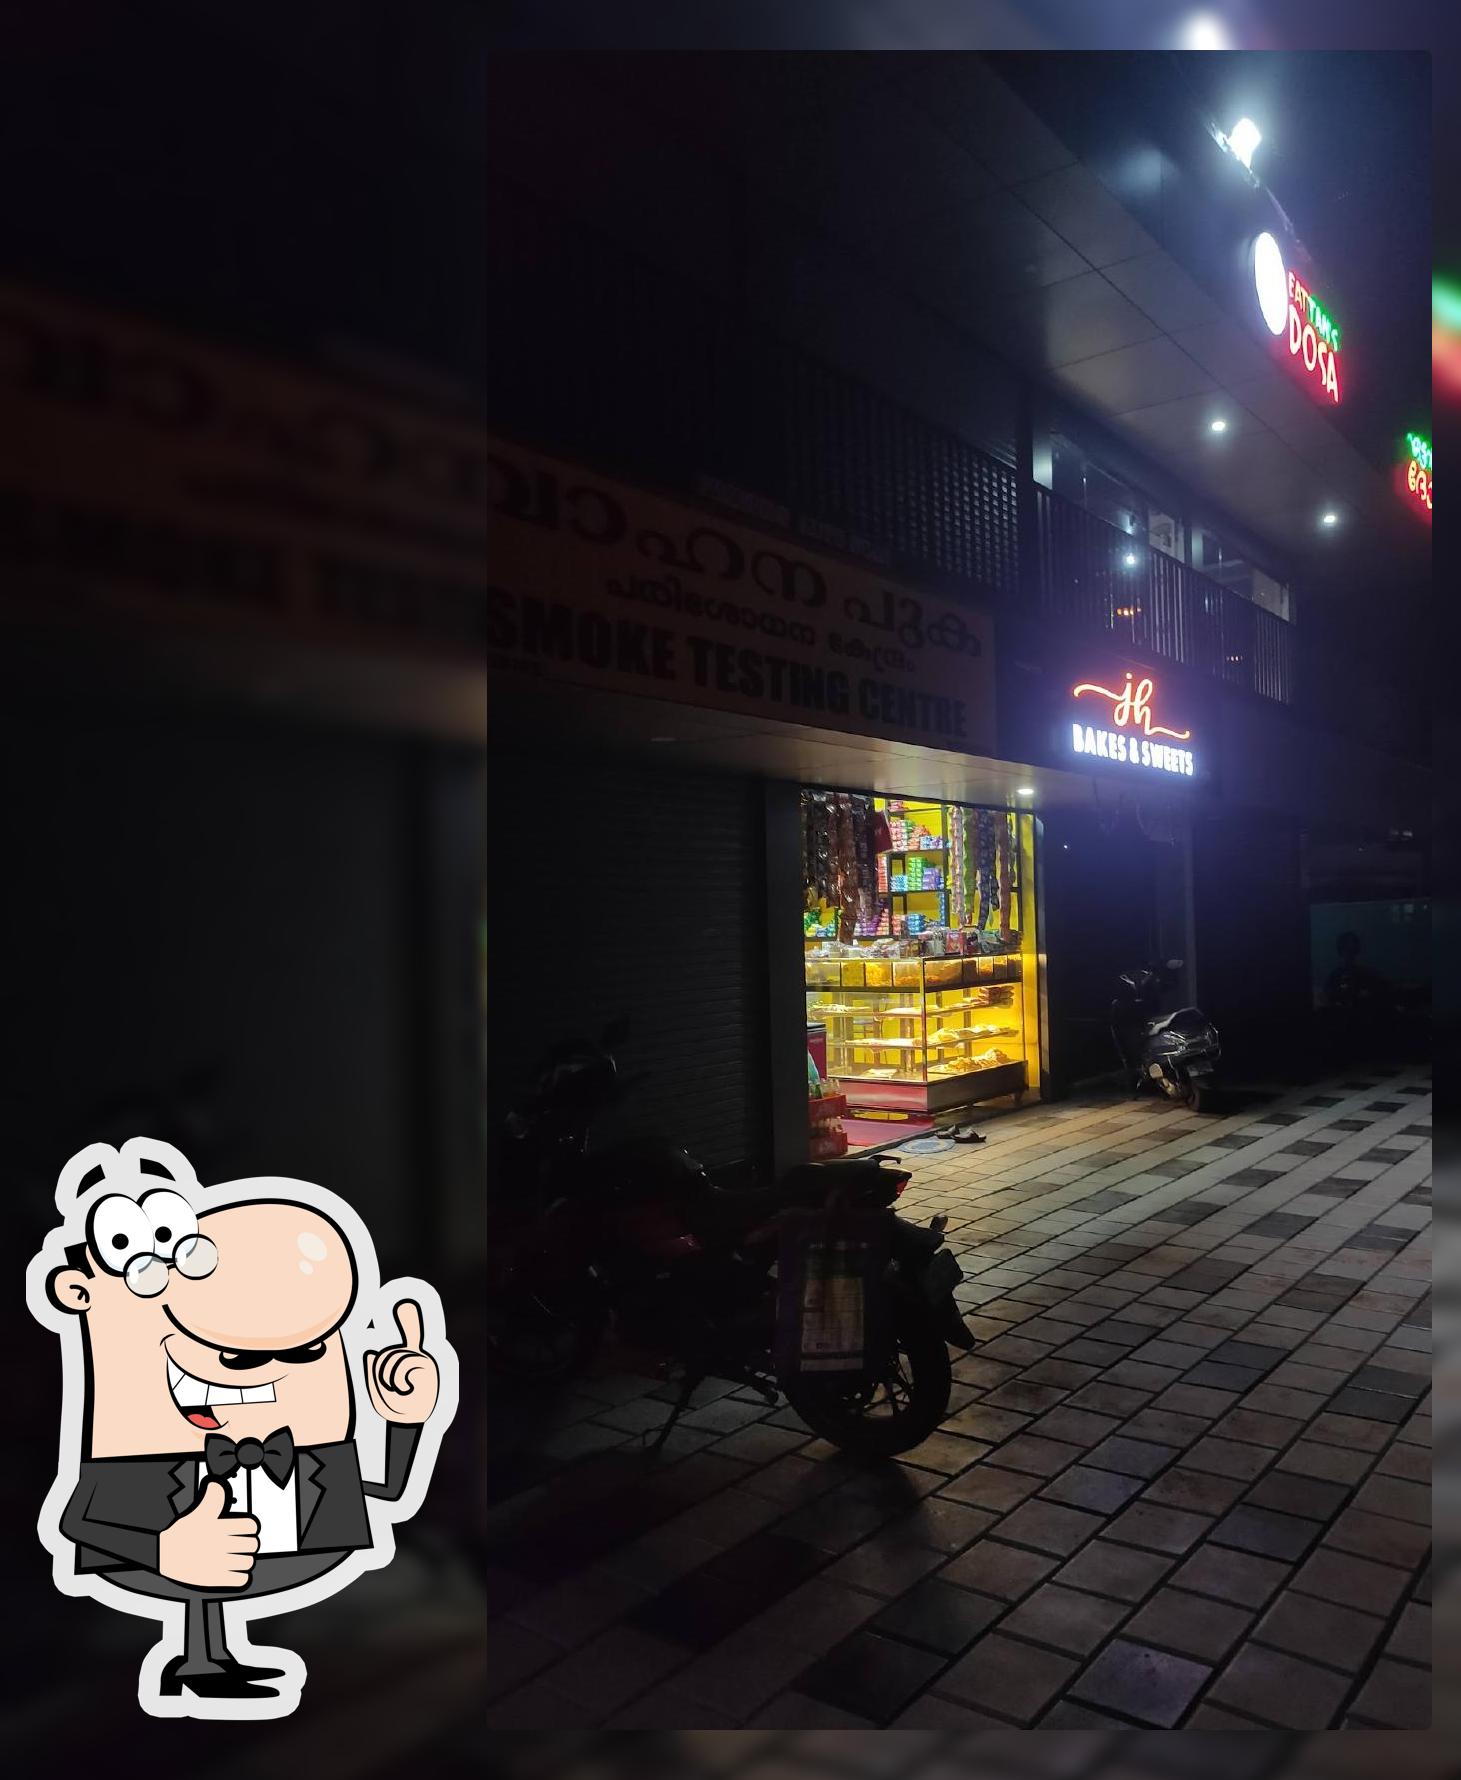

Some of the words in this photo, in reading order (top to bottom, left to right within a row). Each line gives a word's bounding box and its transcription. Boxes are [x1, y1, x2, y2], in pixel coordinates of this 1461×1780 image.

[1289, 303, 1339, 404] DOSA
[488, 583, 676, 681] SMOKE
[687, 634, 850, 717] TESTING
[858, 669, 967, 738] CENTRE
[1072, 723, 1127, 762] BAKES
[1141, 740, 1194, 776] SWEETS
